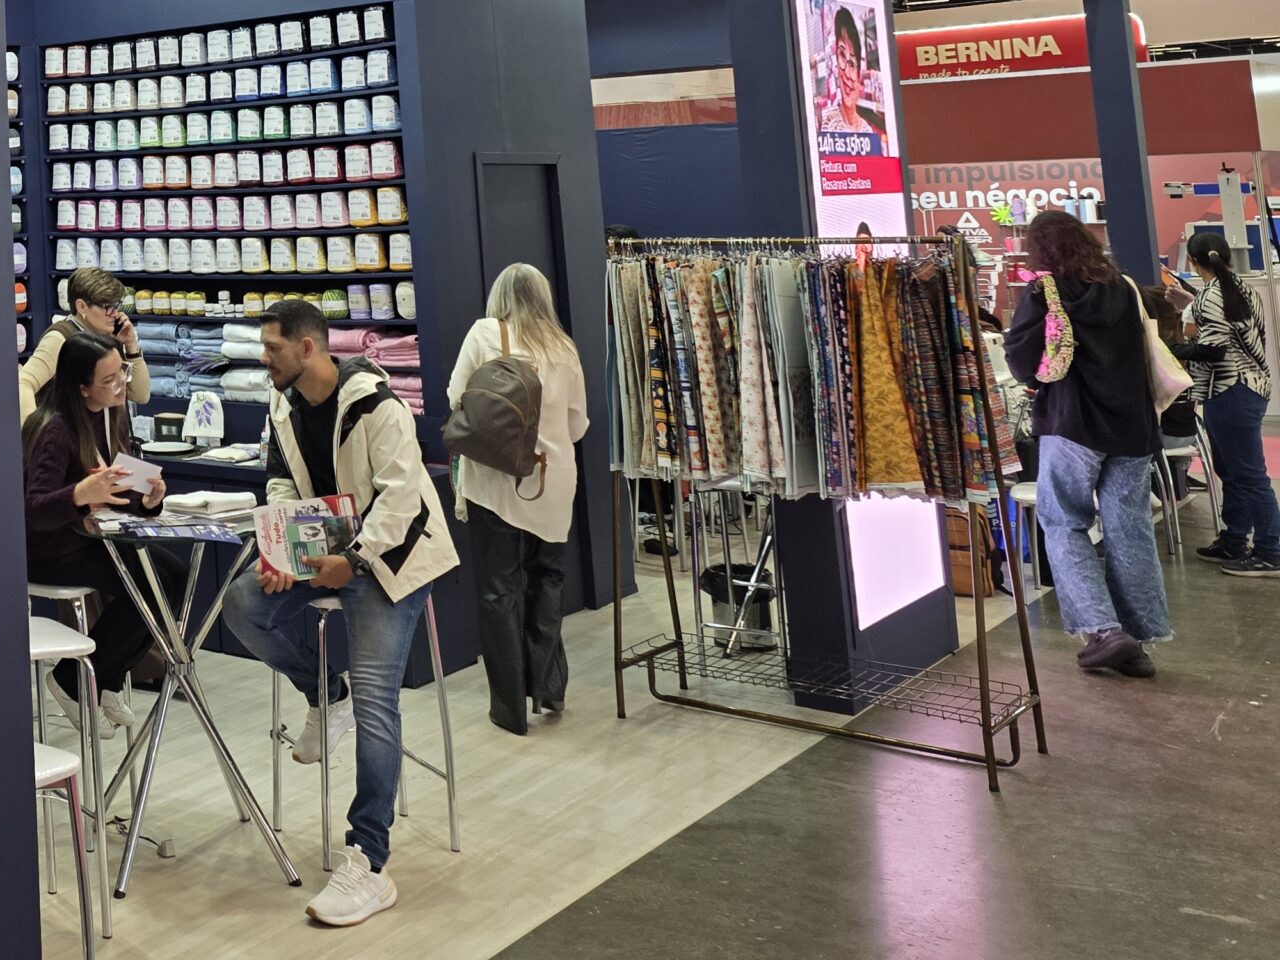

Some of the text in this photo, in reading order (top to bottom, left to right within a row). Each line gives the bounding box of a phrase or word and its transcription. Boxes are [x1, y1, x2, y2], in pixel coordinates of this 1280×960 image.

[915, 34, 1062, 67] BERNINA
[918, 64, 1010, 80] made to create
[818, 133, 871, 156] 14h às 15h30
[844, 163, 857, 172] com
[273, 522, 282, 545] Tudo
